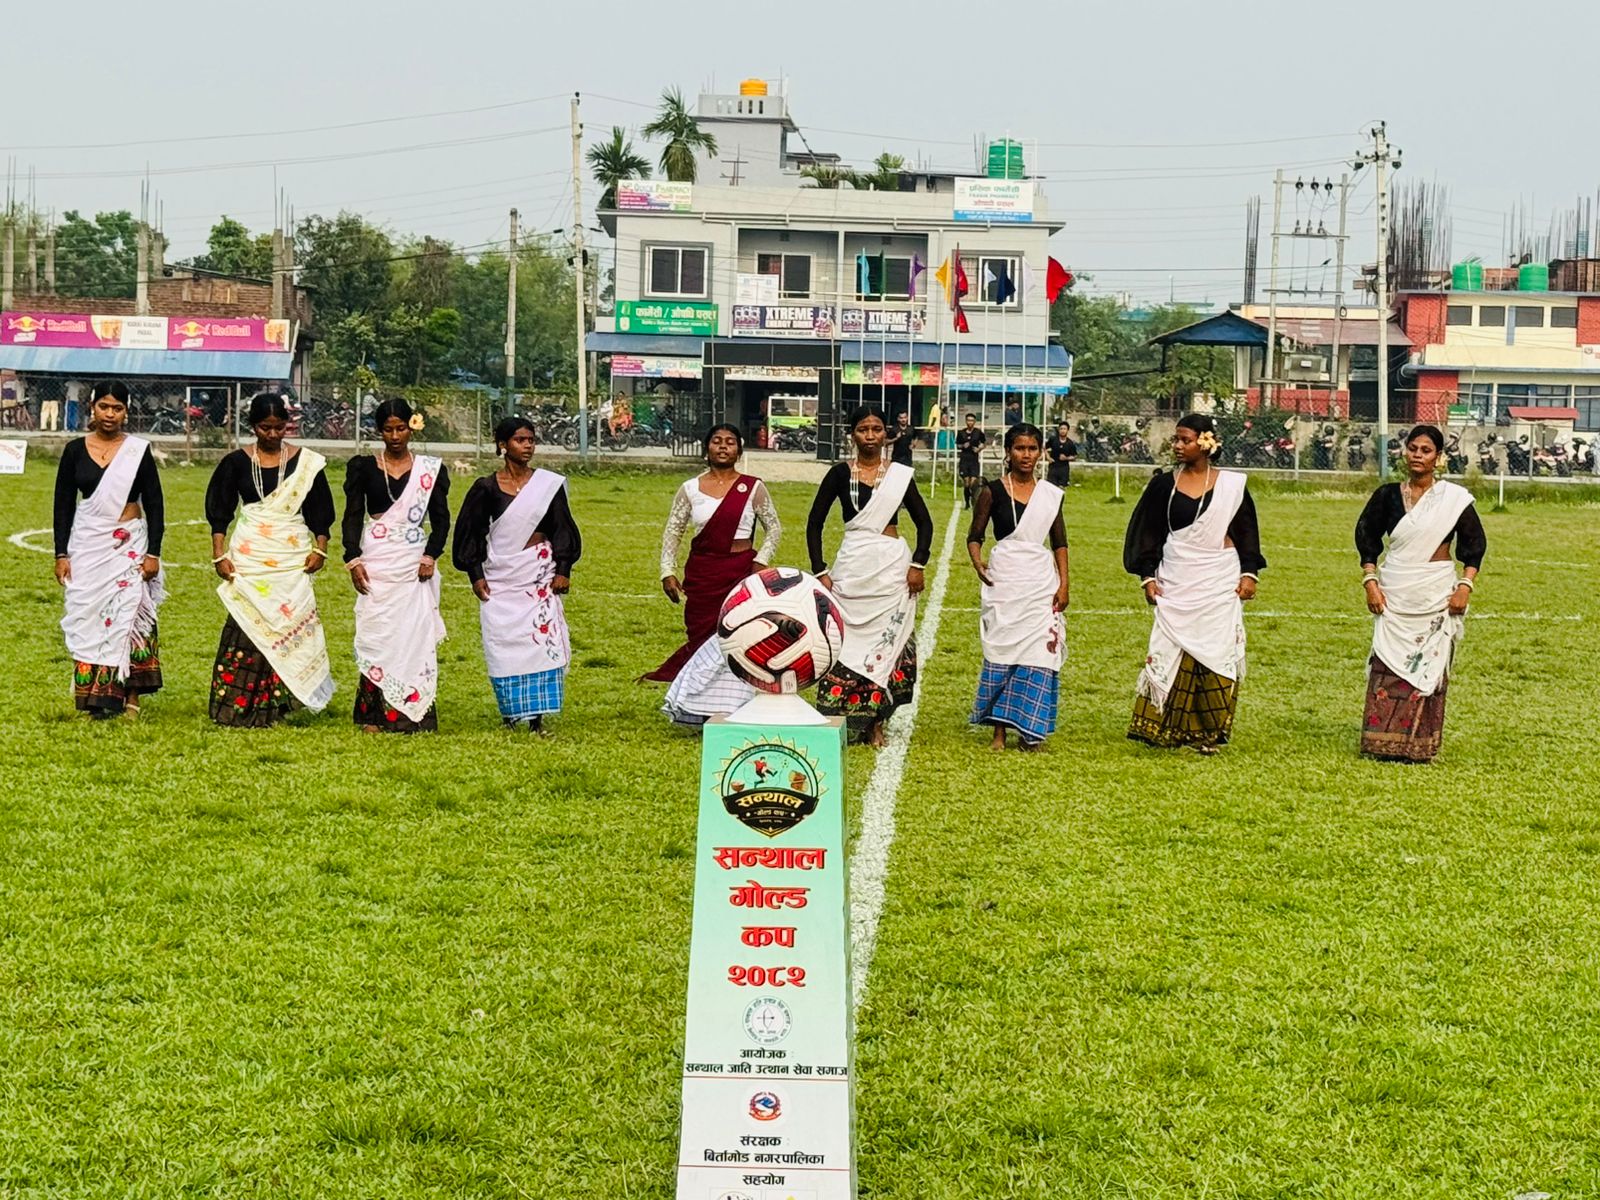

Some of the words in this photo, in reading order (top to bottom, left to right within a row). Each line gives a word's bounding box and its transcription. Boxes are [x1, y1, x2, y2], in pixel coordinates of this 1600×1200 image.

[765, 307, 814, 320] XTREME
[765, 319, 791, 328] ENERGY
[792, 320, 814, 329] DRINK
[735, 792, 805, 809] सन्थाल
[712, 847, 828, 870] सन्थाल
[729, 880, 811, 909] गोल्ड
[741, 926, 798, 948] कप
[727, 965, 807, 988] २०८२
[739, 1047, 787, 1059] आयोजक
[685, 1063, 724, 1074] सन्थाल
[727, 1062, 752, 1074] जाति
[755, 1064, 789, 1075] उत्थान
[792, 1063, 813, 1076] सेवा
[816, 1066, 848, 1077] समाज
[739, 1134, 783, 1147] संरक्षक
[704, 1149, 750, 1163] बिर्तामोड
[754, 1151, 825, 1165] नगरपालिका
[742, 1172, 785, 1186] सहयोग
